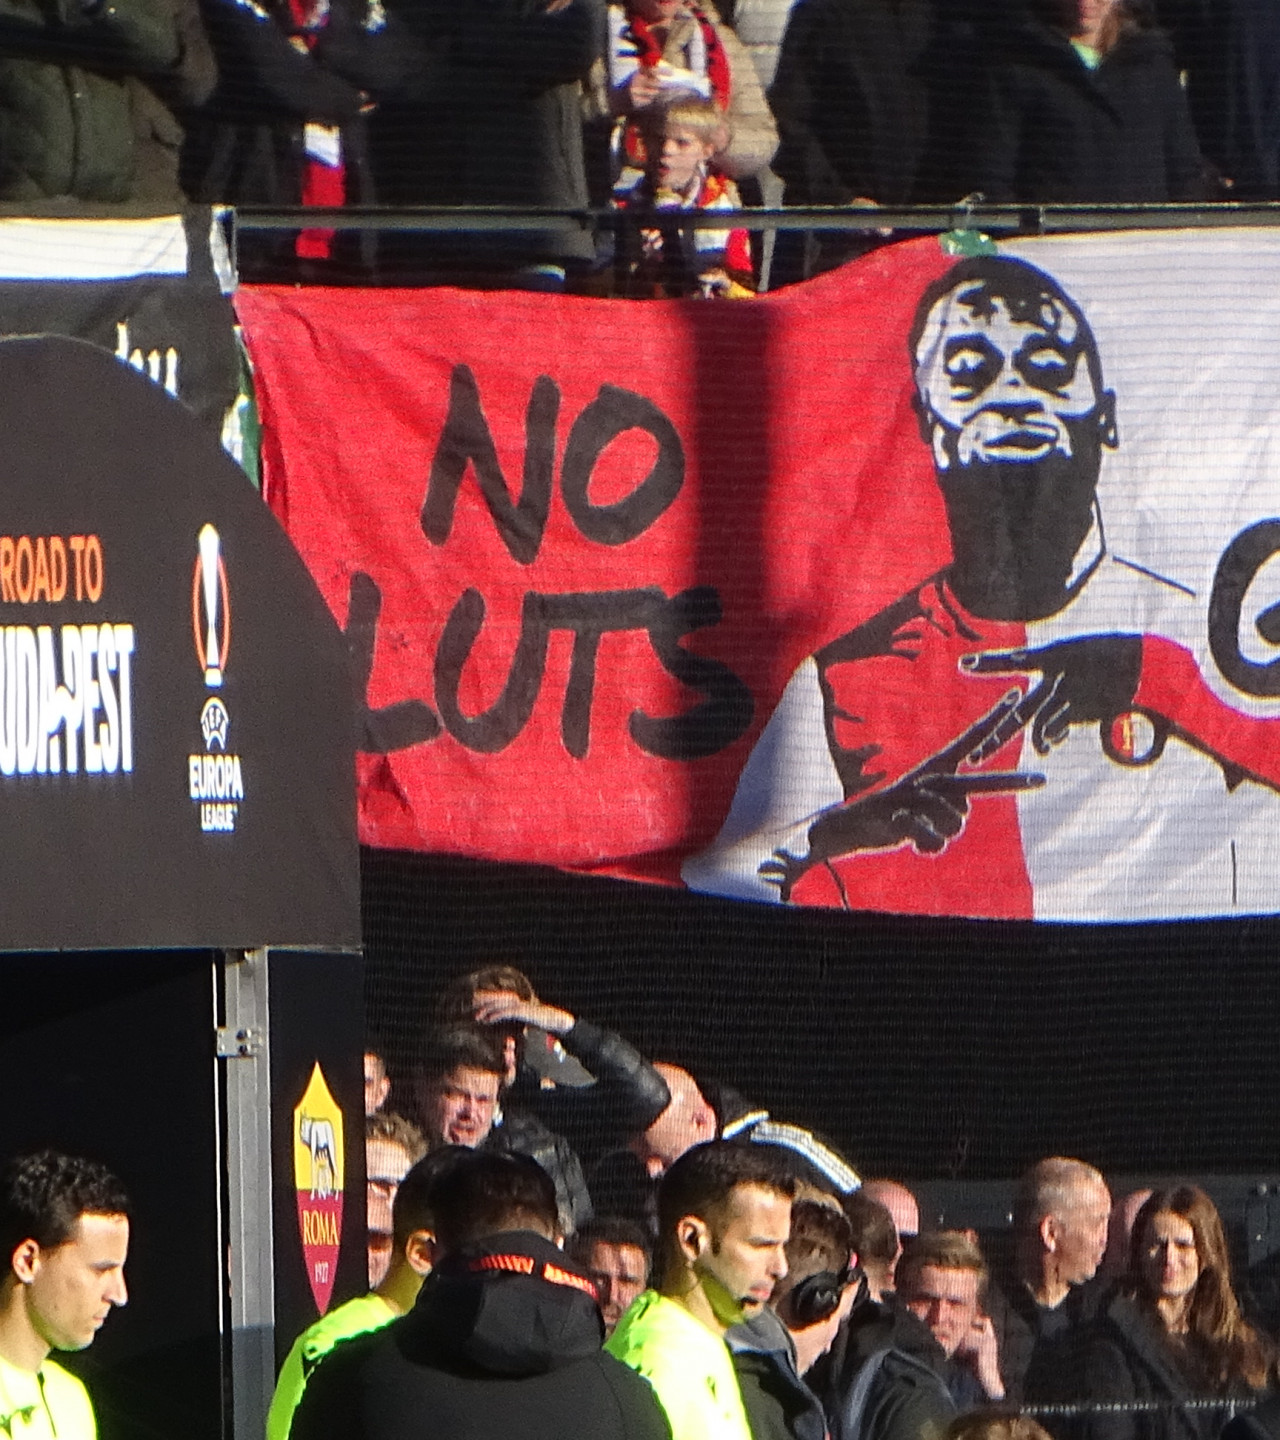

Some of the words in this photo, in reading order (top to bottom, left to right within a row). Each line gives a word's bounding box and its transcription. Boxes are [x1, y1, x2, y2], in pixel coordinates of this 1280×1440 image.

[421, 362, 687, 564] NO
[69, 534, 104, 603] TO
[188, 754, 244, 800] EUROPA
[302, 1209, 341, 1246] ROMA
